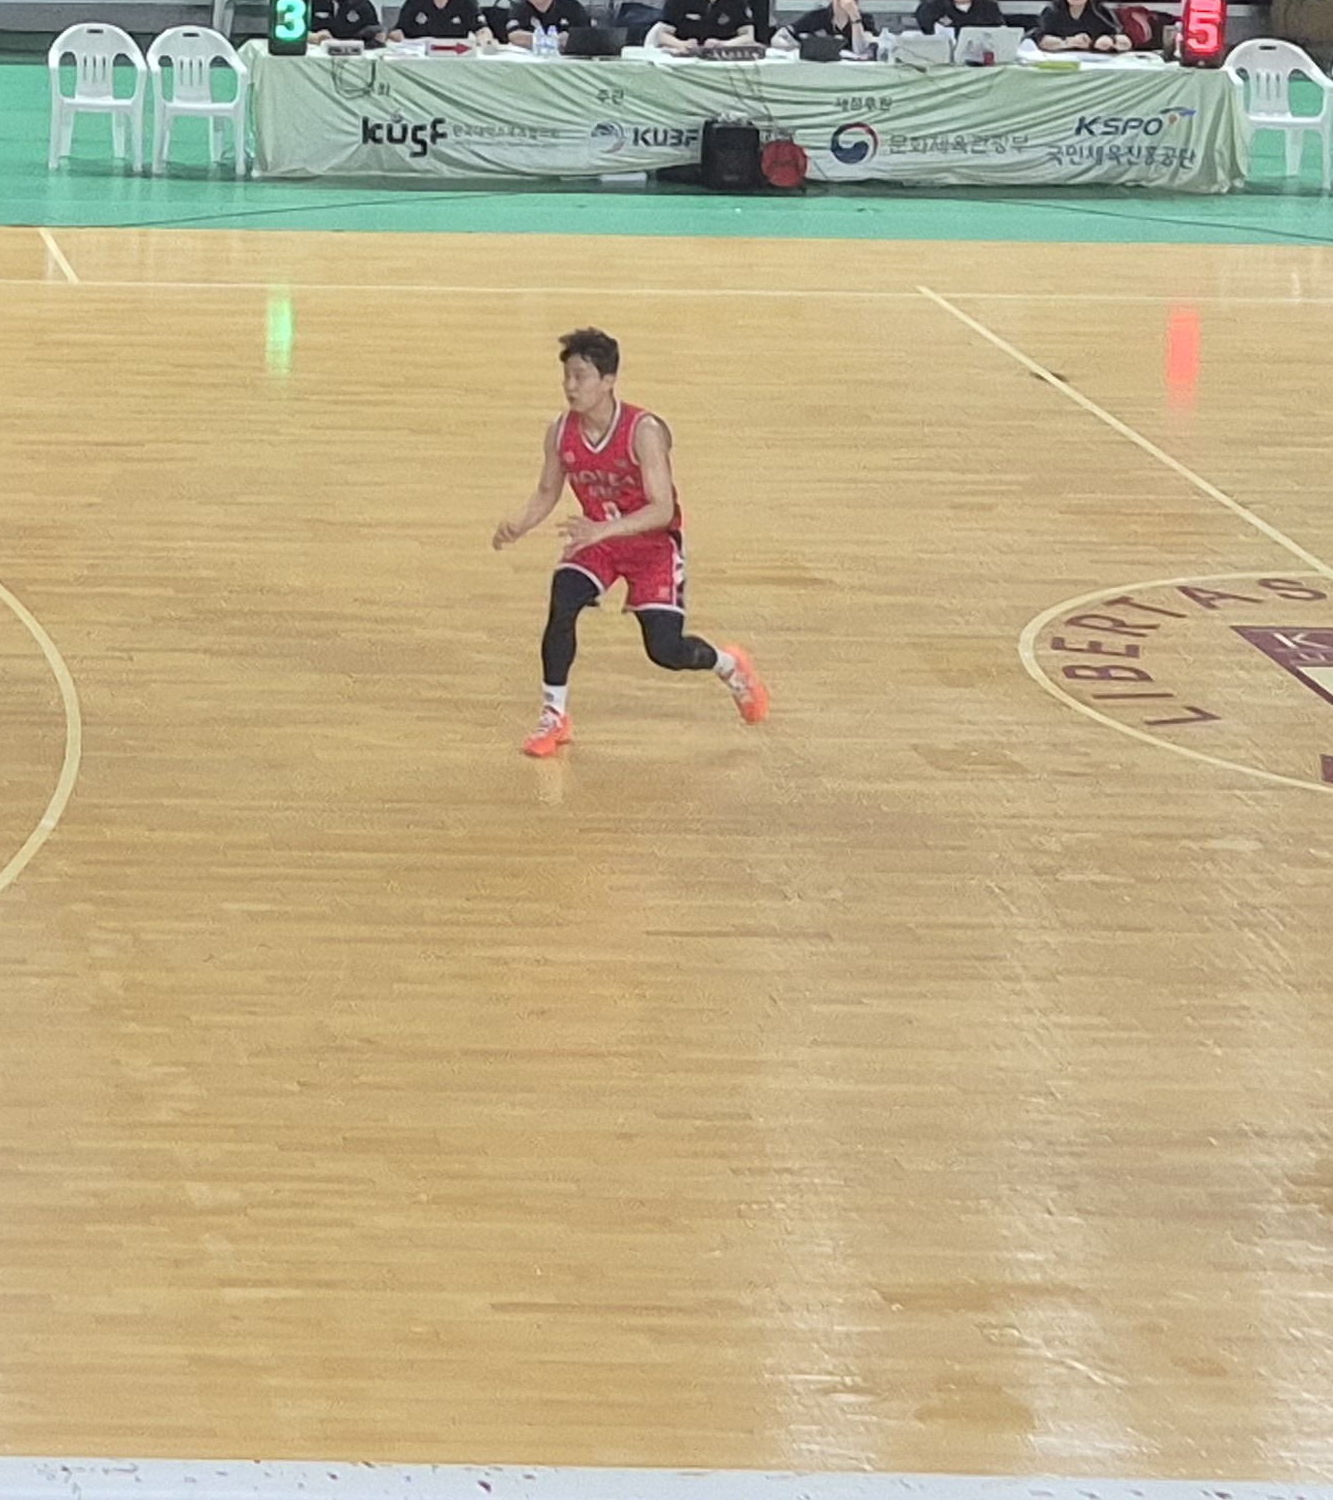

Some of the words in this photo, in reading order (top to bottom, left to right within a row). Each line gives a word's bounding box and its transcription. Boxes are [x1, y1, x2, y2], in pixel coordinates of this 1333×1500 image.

[361, 115, 448, 158] kusf
[632, 127, 699, 148] KUBF
[1074, 115, 1163, 136] KSPO
[1049, 577, 1328, 726] LIBERTAS
